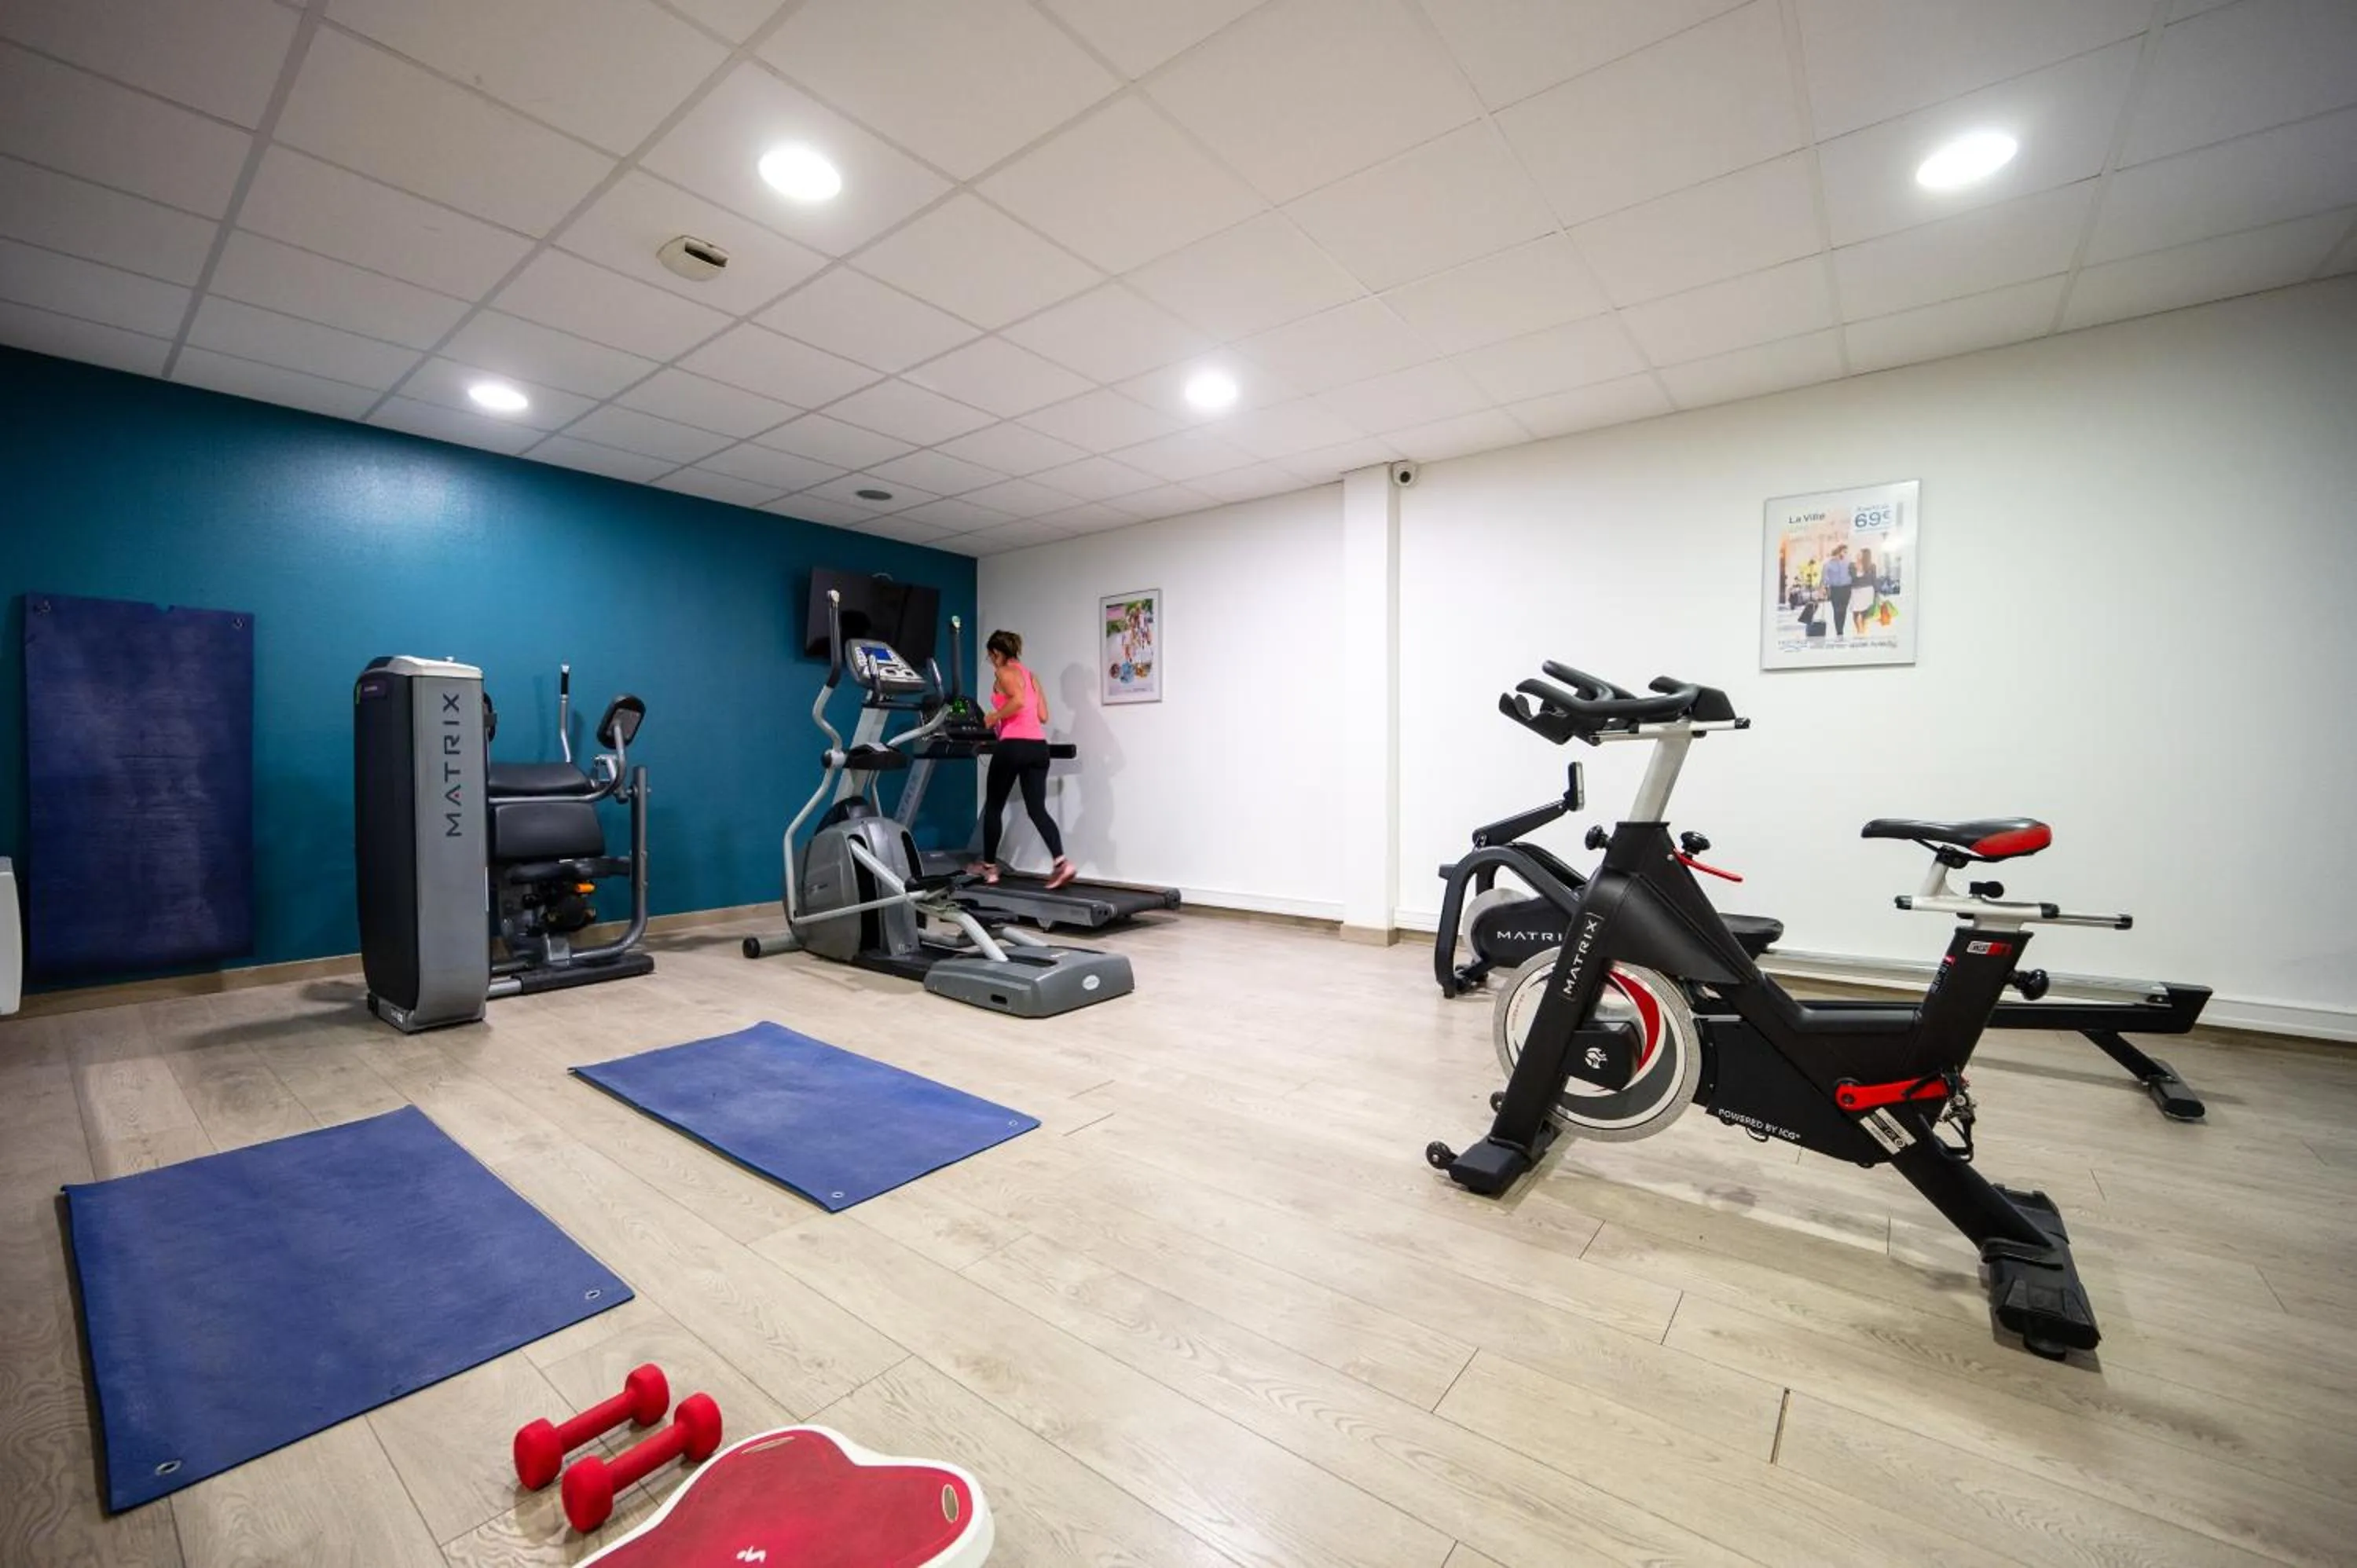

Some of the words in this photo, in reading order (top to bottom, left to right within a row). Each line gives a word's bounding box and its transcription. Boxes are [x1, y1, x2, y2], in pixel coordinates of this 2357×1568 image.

[443, 693, 462, 837] MATRIX
[1497, 931, 1562, 941] MATRI
[1563, 919, 1597, 994] MATRIX
[1718, 1108, 1763, 1128] POWERED
[1765, 1123, 1778, 1133] BY
